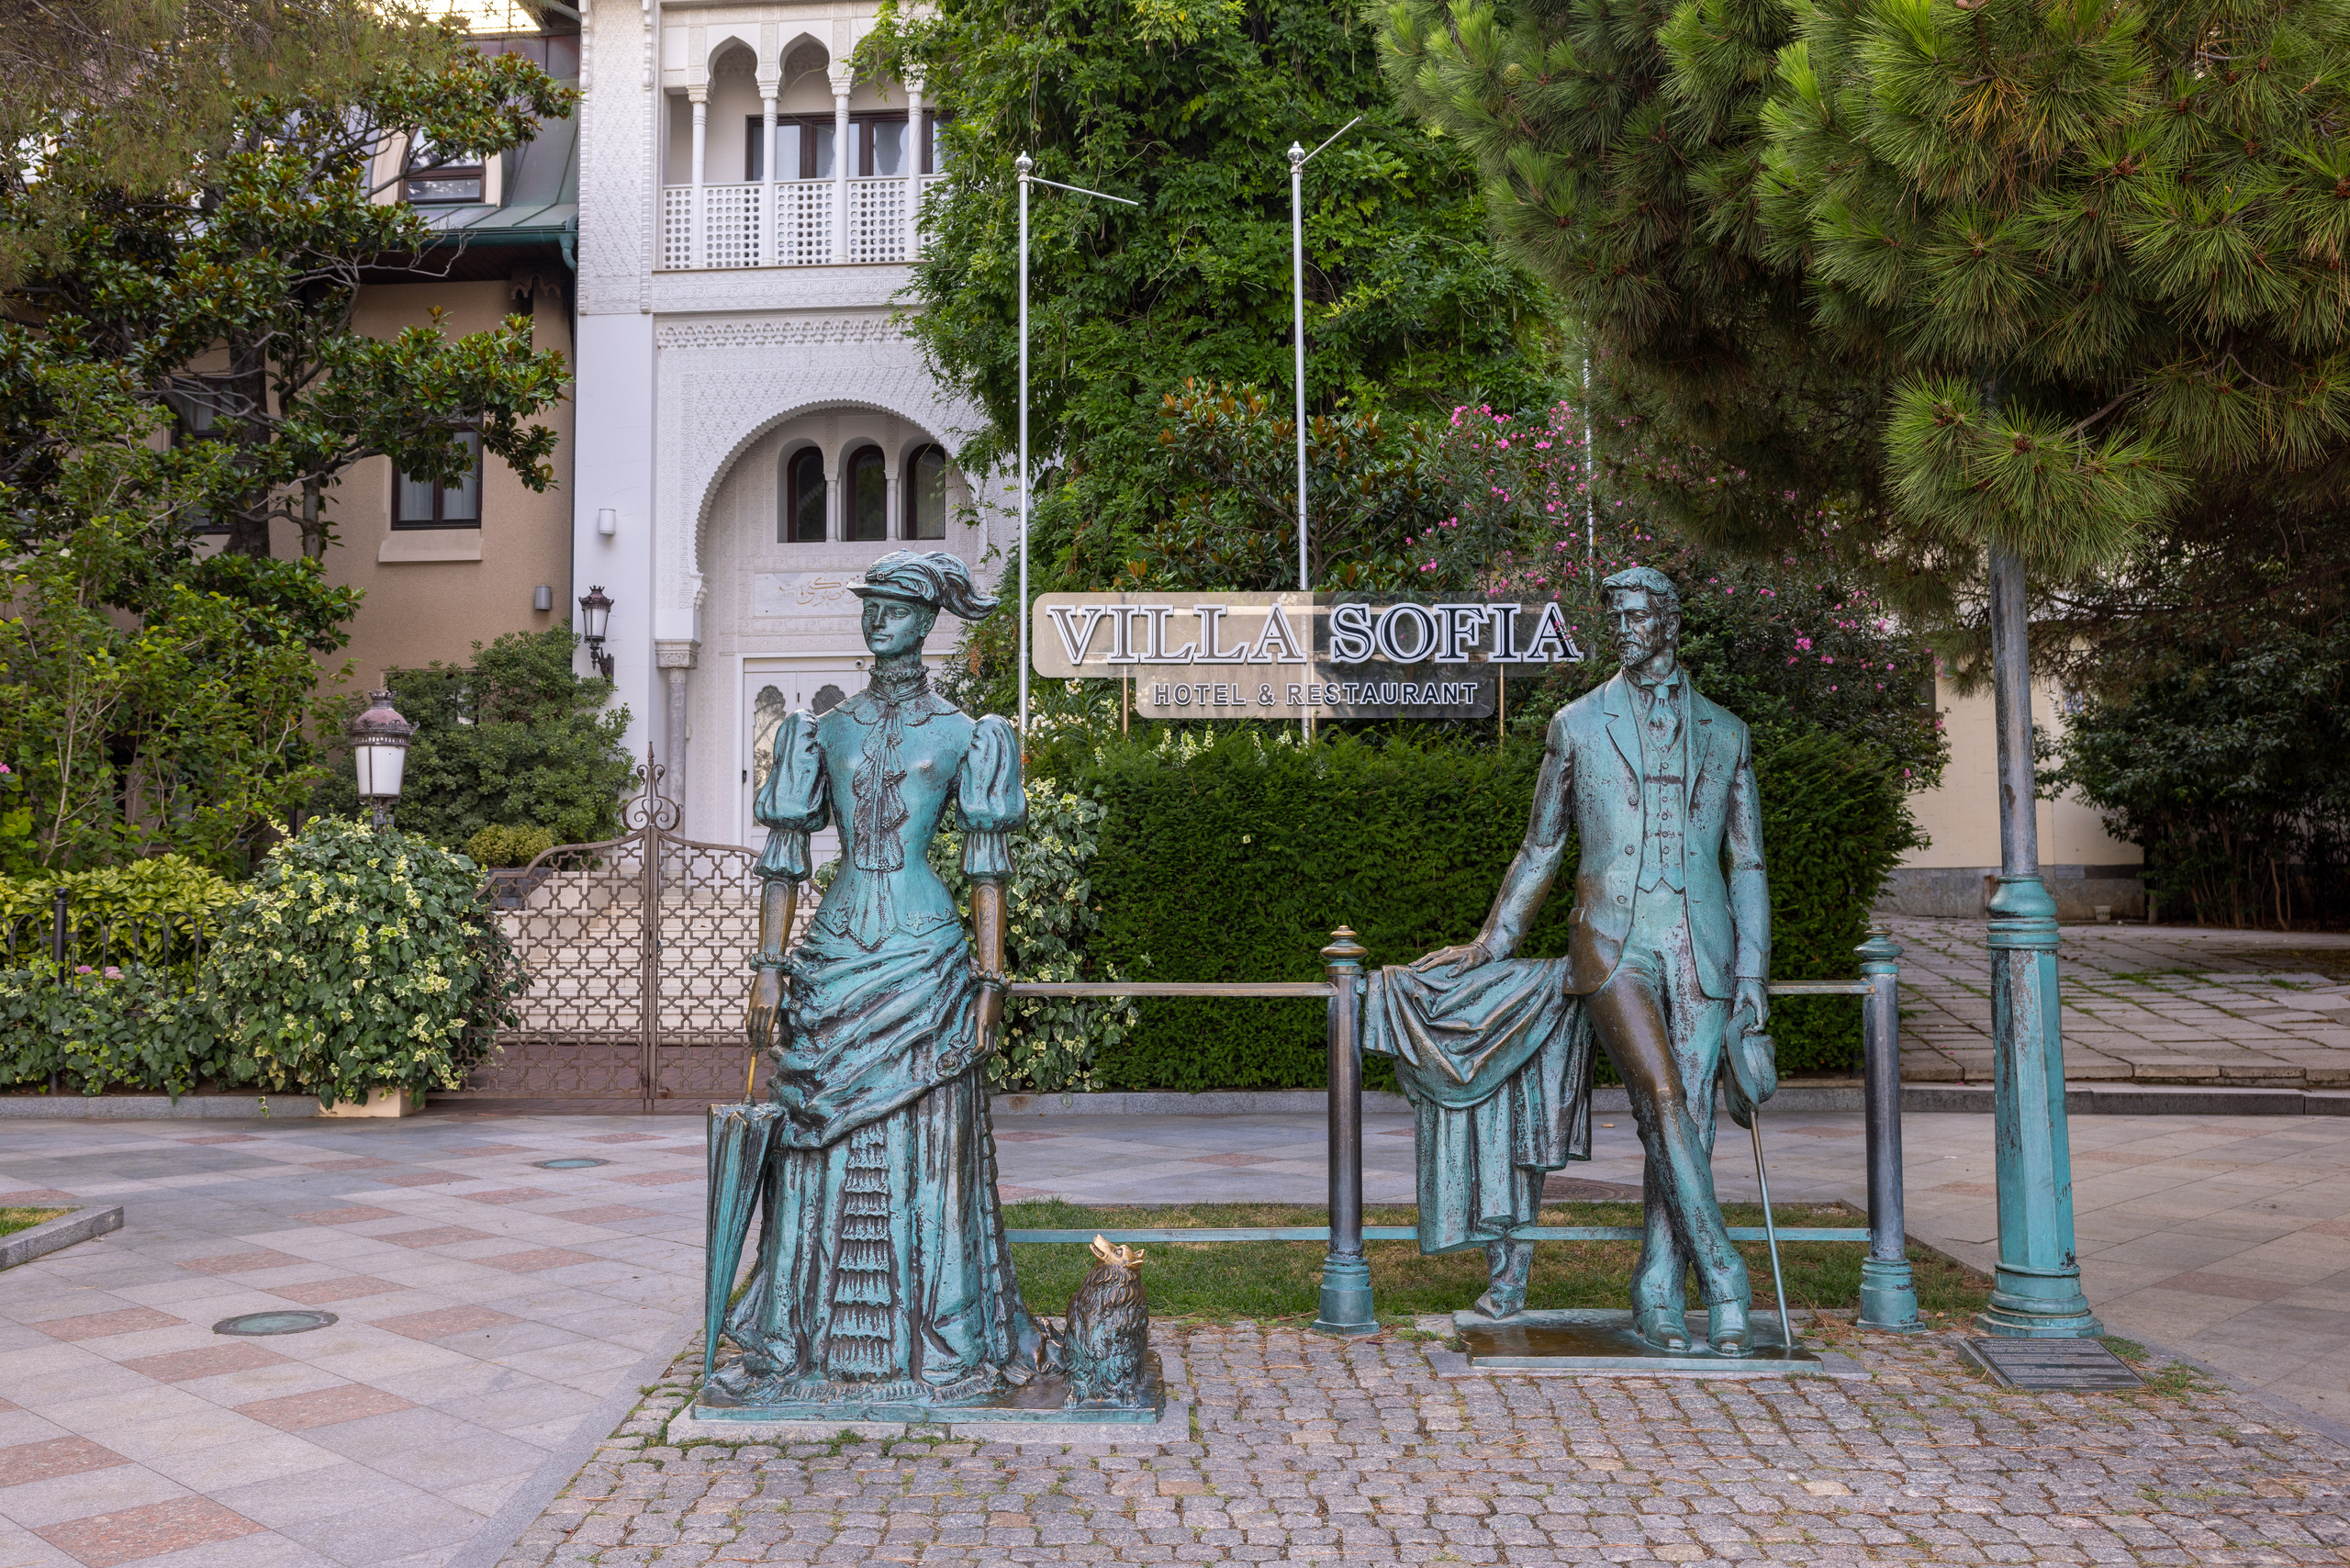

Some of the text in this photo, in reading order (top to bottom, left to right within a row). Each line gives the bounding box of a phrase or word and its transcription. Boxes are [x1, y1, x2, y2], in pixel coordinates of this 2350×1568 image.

[1046, 602, 1584, 665] VILLA SOFIA
[1153, 682, 1478, 706] HOTEL & RESTAURANT
